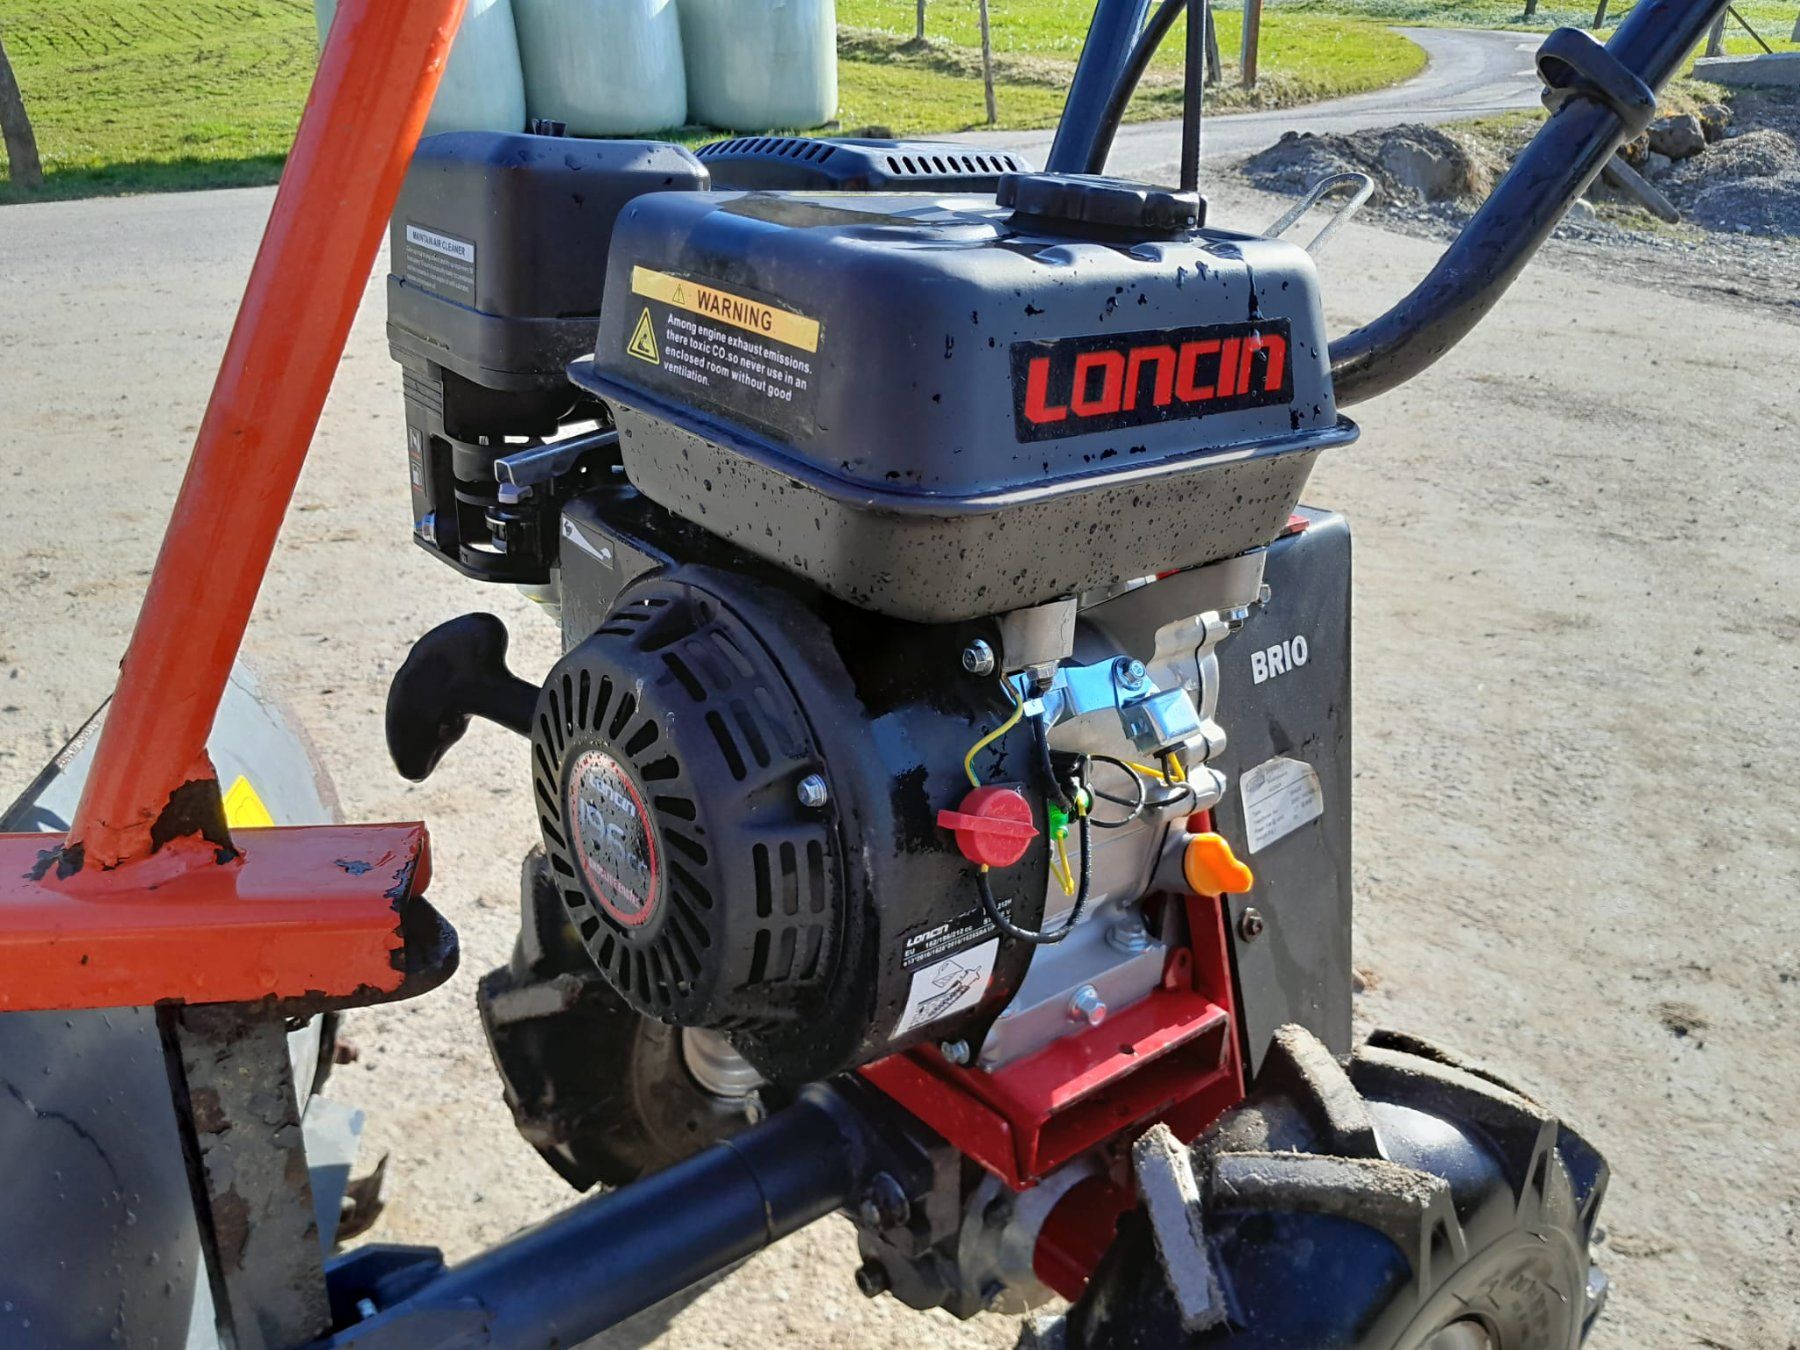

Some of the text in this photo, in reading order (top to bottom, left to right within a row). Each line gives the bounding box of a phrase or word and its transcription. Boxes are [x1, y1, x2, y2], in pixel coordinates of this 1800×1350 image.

[441, 241, 466, 256] CLEANER
[697, 289, 773, 331] WARNING
[666, 329, 688, 345] there
[690, 335, 711, 354] toxic
[740, 357, 765, 374] never
[766, 366, 783, 381] use
[784, 371, 794, 384] in
[795, 377, 808, 390] an
[667, 313, 813, 374] Among engine exhaust emissions.
[664, 361, 710, 386] ventilation.
[665, 346, 793, 401] enclosed room without good
[1024, 334, 1286, 424] LONCIN
[1250, 634, 1308, 685] BRIO
